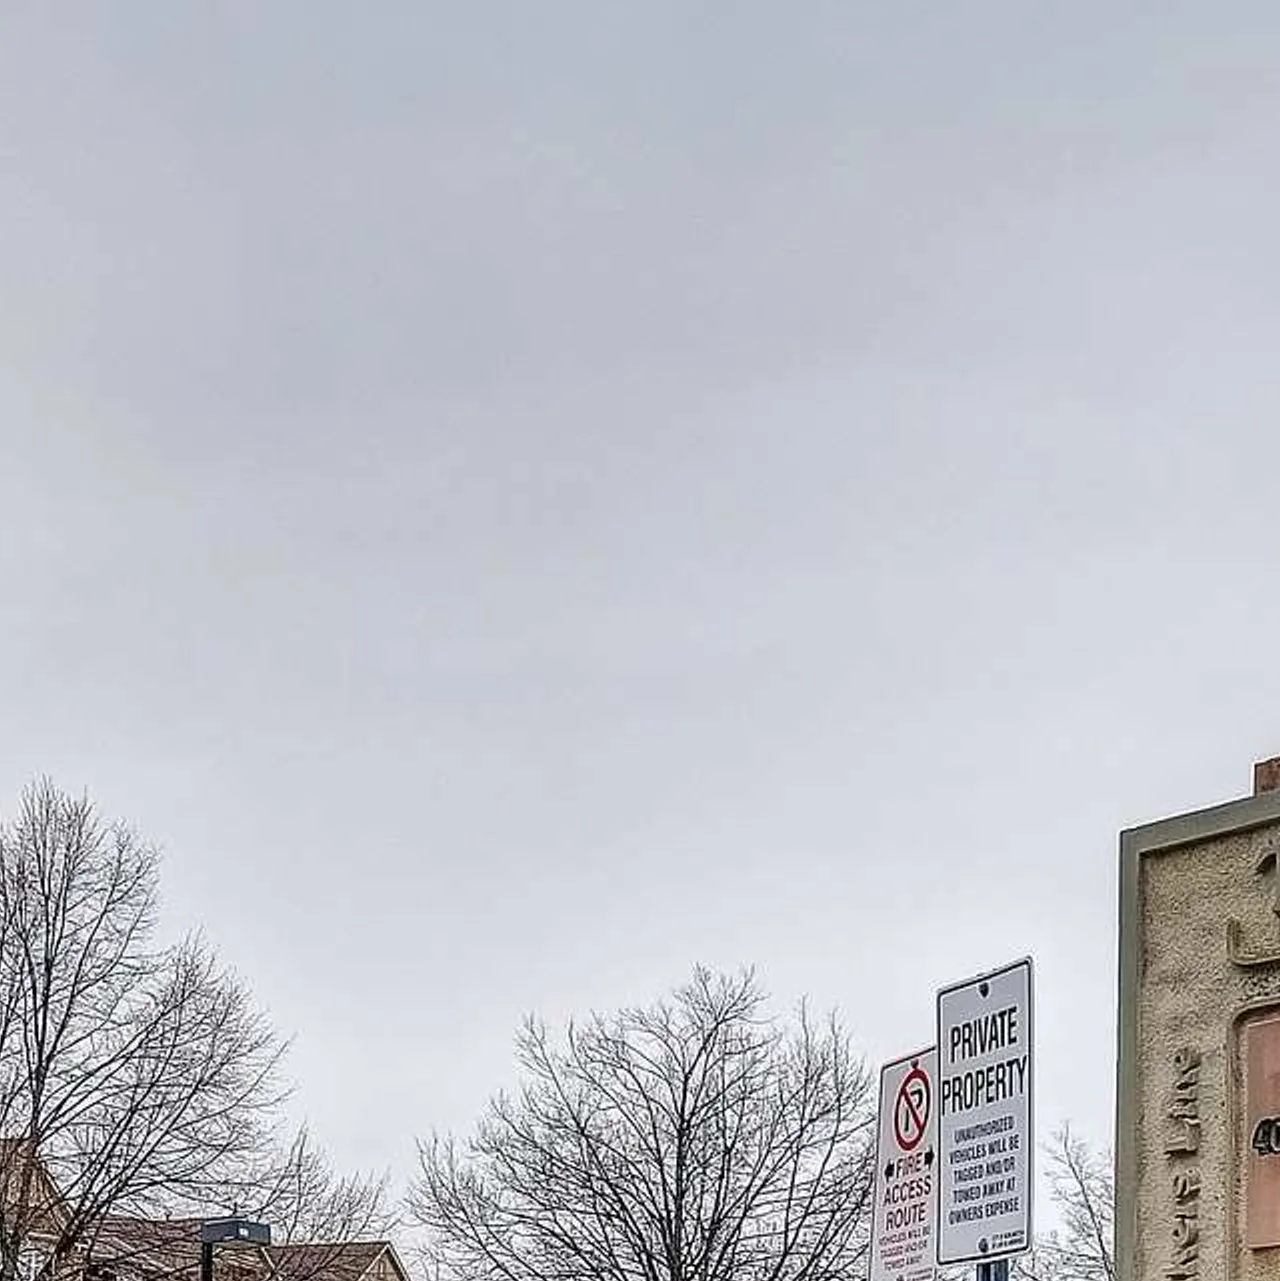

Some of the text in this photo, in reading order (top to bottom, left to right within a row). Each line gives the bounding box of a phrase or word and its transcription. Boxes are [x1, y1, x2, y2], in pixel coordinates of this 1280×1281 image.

[951, 1006, 1017, 1063] PRIVATE
[941, 1054, 1027, 1116] PROPERTY
[1162, 1046, 1202, 1161] Line
[949, 1133, 1020, 1165] VEHICLES WILL BE
[895, 1152, 923, 1179] FIRE
[953, 1163, 983, 1185] TAGGED
[883, 1174, 932, 1208] ACCESS
[953, 1176, 1016, 1204] TOWED AWAY AT
[885, 1201, 927, 1232] ROUTE
[948, 1196, 1019, 1225] OWNERS EXPENSE
